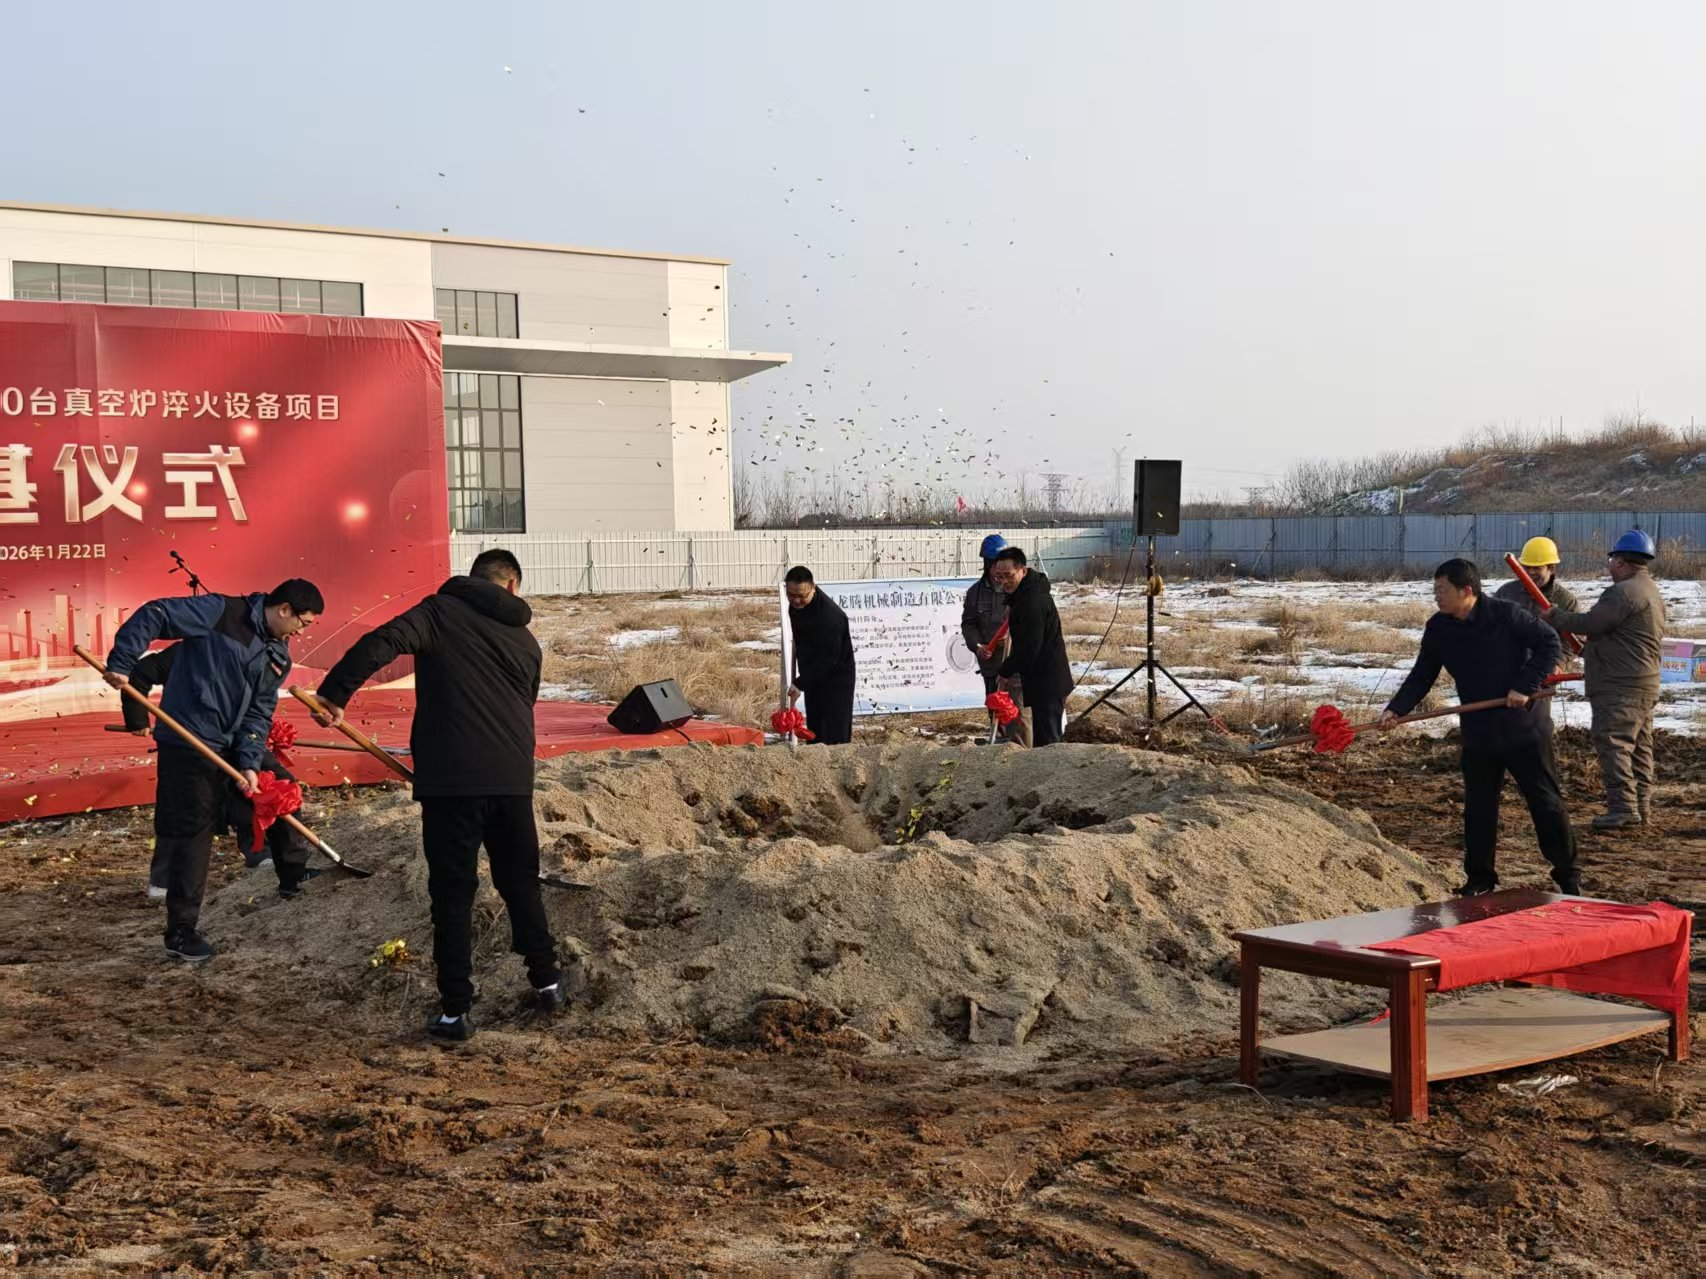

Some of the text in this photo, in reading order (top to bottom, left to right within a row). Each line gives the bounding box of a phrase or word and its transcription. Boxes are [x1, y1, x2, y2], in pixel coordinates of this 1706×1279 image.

[0, 386, 339, 421] 0台真空炉淬火设备项目
